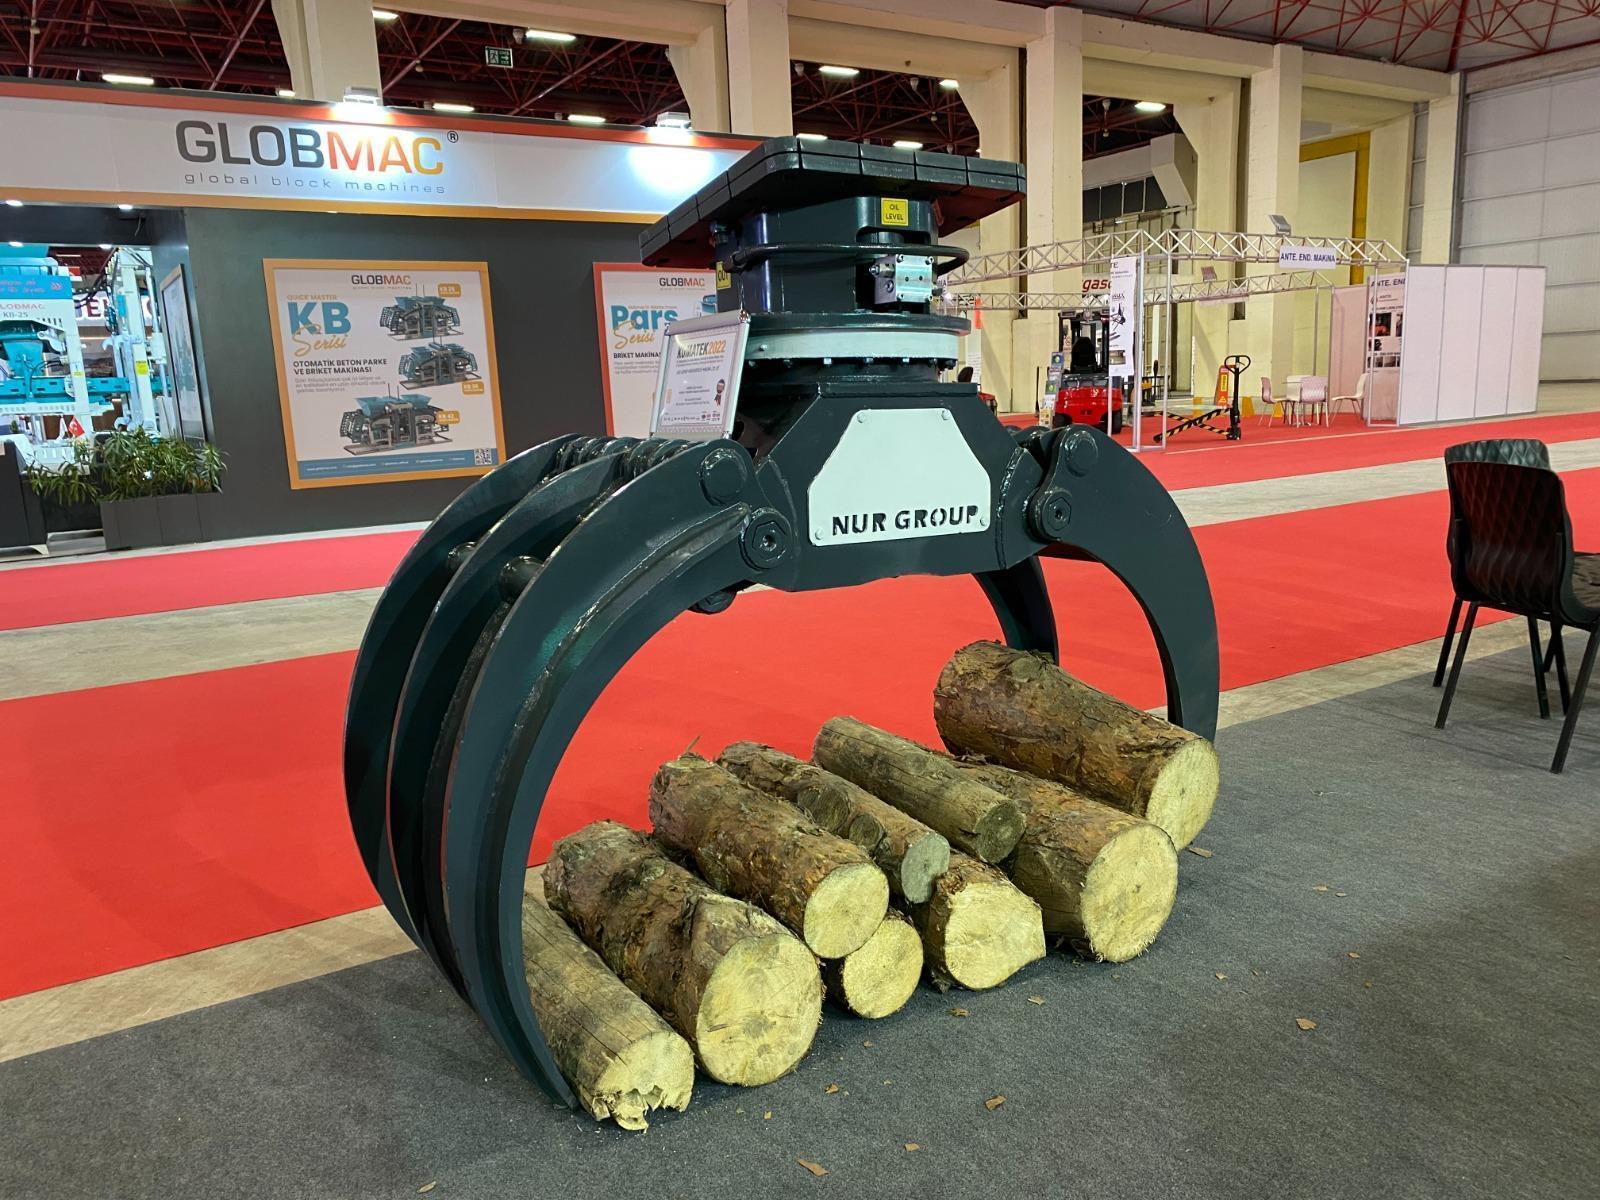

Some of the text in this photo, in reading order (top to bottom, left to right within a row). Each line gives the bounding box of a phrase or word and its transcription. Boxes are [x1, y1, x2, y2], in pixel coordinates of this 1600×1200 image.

[176, 120, 443, 175] GLOBMAC
[184, 172, 446, 194] global block machines
[889, 203, 900, 211] OIL
[885, 213, 904, 221] LEVEL
[351, 274, 411, 285] GLOBMAC
[659, 277, 706, 287] GLOBMAC
[288, 301, 351, 335] KB
[610, 305, 679, 331] Pars
[336, 358, 362, 366] BETON
[832, 505, 979, 536] NUR GROUP
